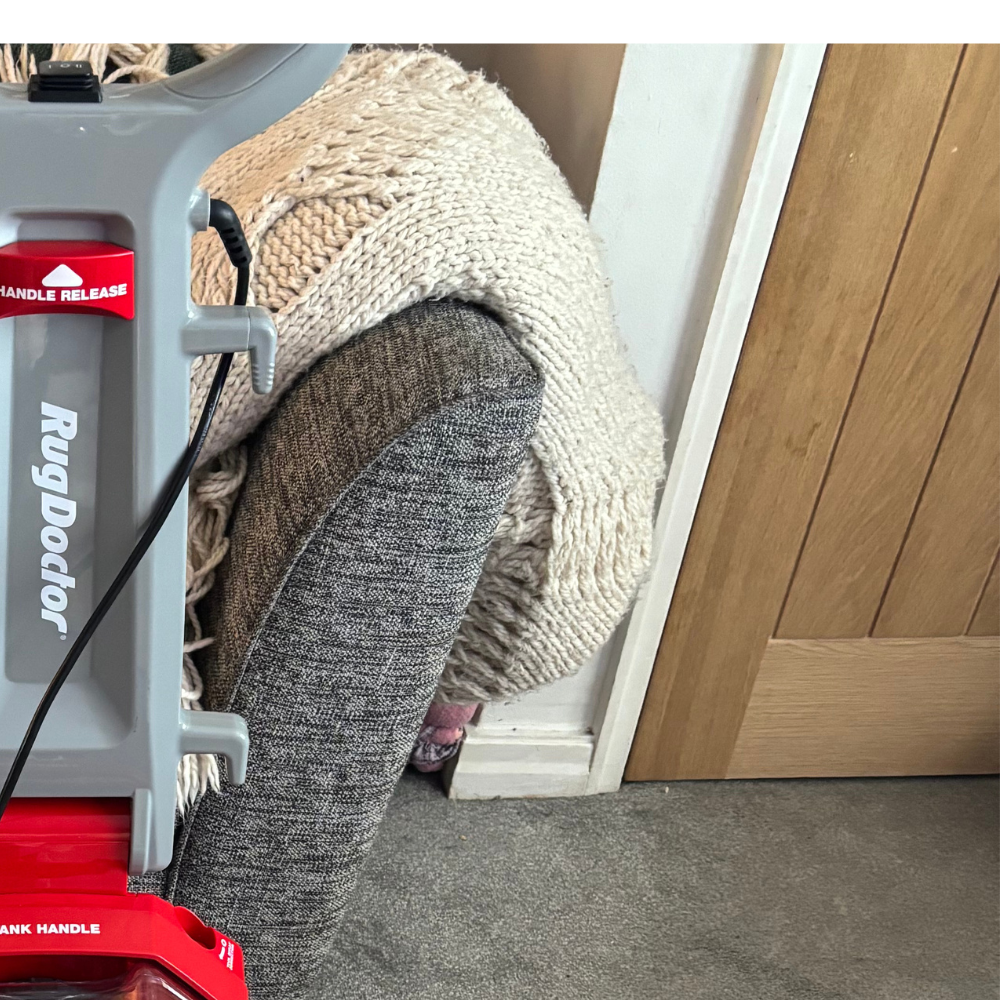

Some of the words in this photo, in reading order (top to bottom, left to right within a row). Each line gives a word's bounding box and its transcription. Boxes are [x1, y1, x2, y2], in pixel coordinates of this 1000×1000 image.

[61, 283, 127, 302] RELEASE
[32, 401, 78, 635] RugDoctor
[36, 924, 100, 934] HANDLE
